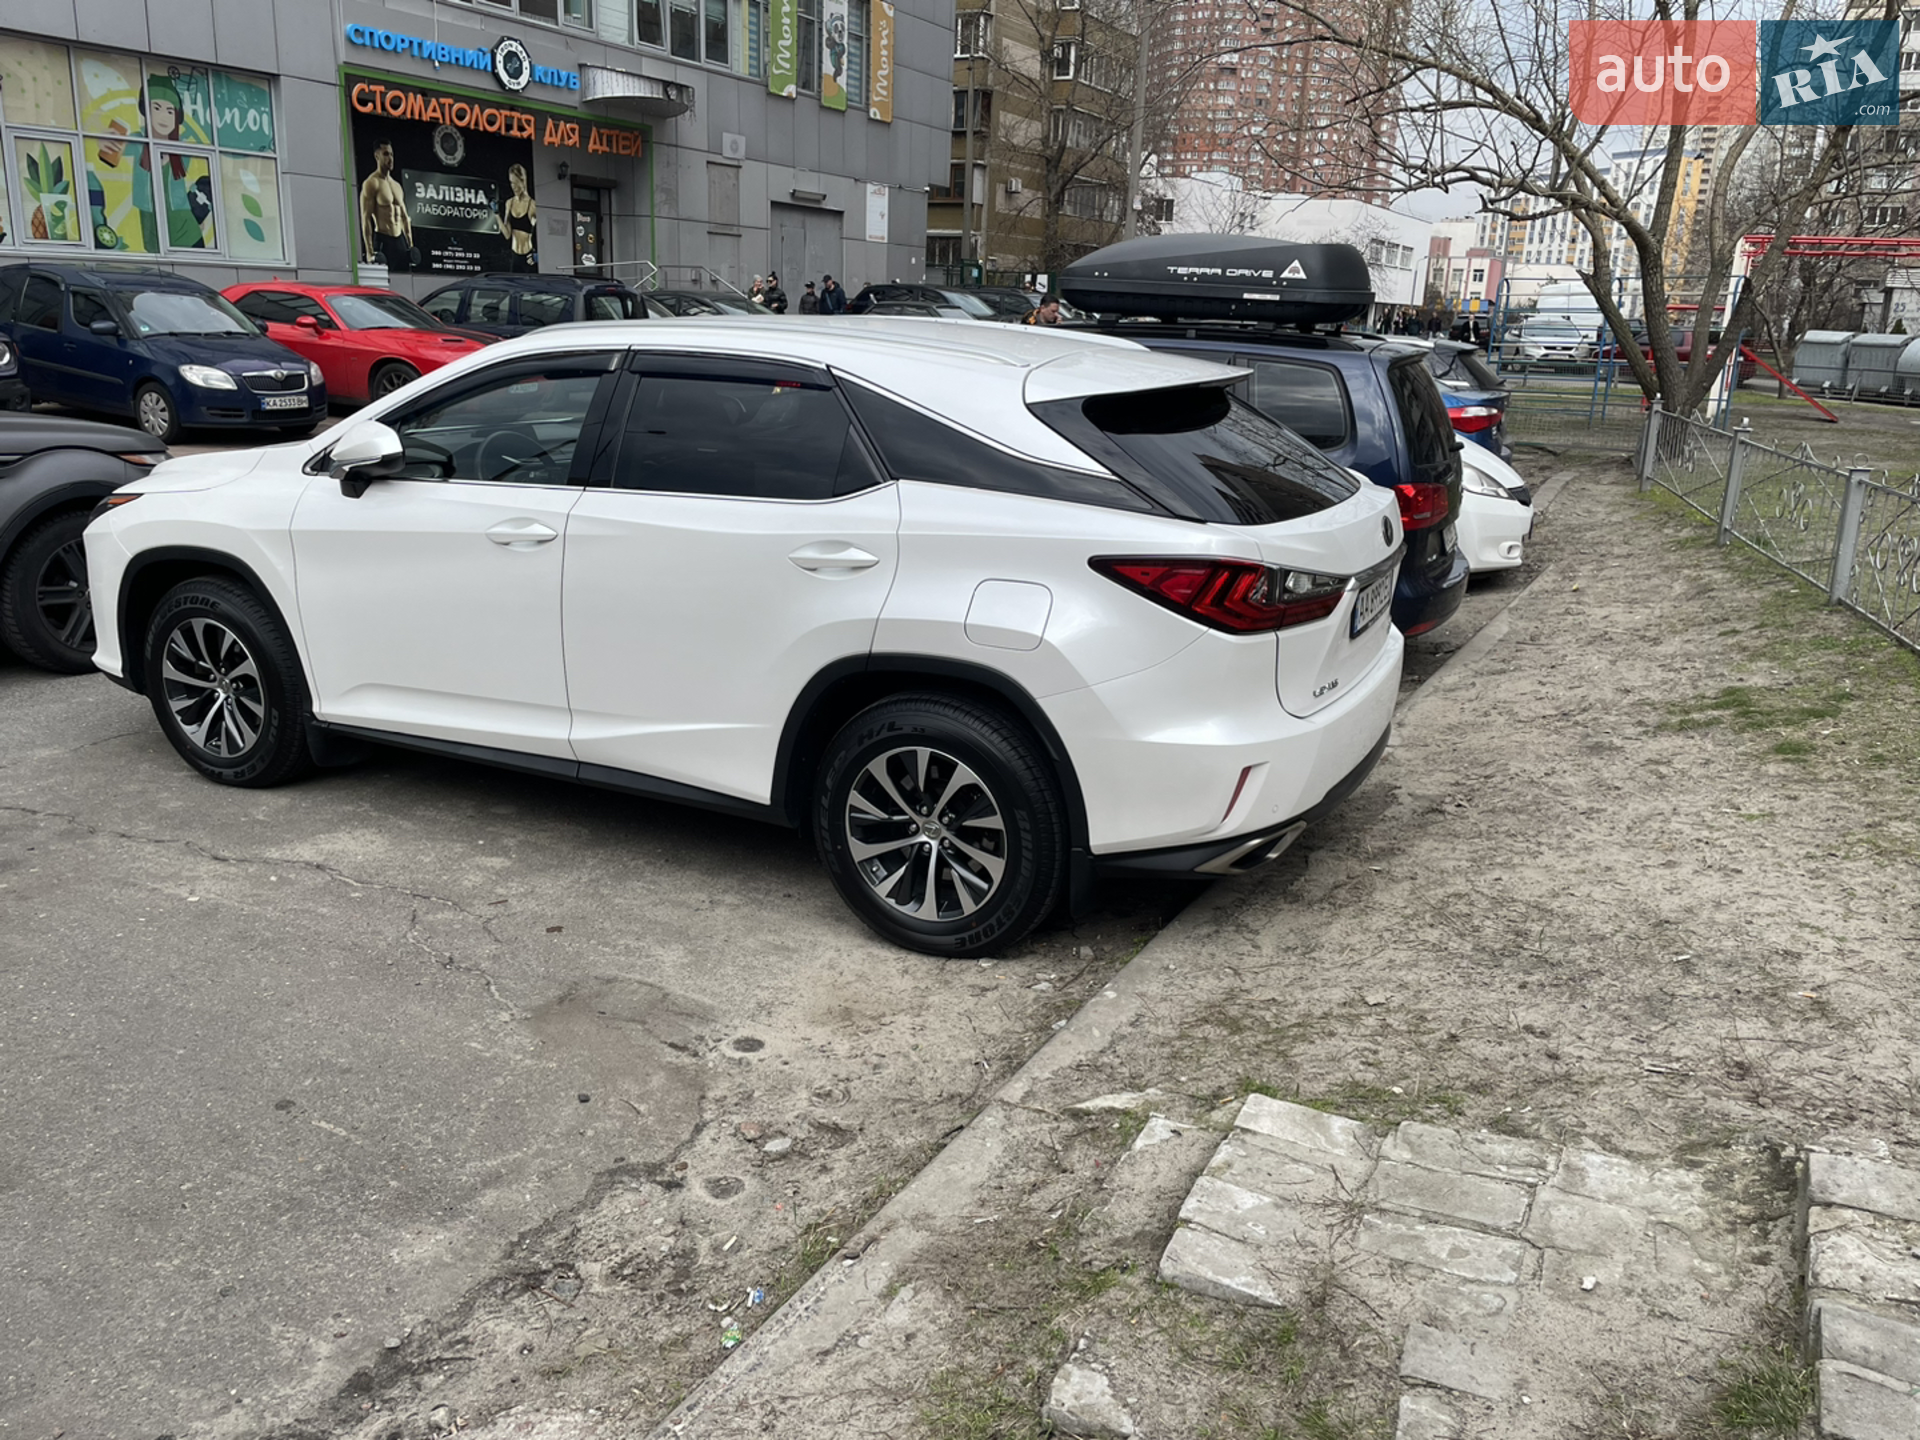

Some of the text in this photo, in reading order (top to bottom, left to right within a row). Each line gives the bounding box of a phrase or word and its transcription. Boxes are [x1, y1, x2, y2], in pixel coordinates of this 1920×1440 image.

[346, 23, 581, 90] СПОРТИВНИЙ КЛУБ
[352, 83, 643, 158] СТОМАТОЛОГІЯ ДЛЯ ДІТЕЙ
[415, 182, 488, 205] ЗАЛІЗНА
[416, 202, 489, 219] ЛАБОРАТОРІЯ
[1167, 266, 1275, 278] TERRA DRIVE
